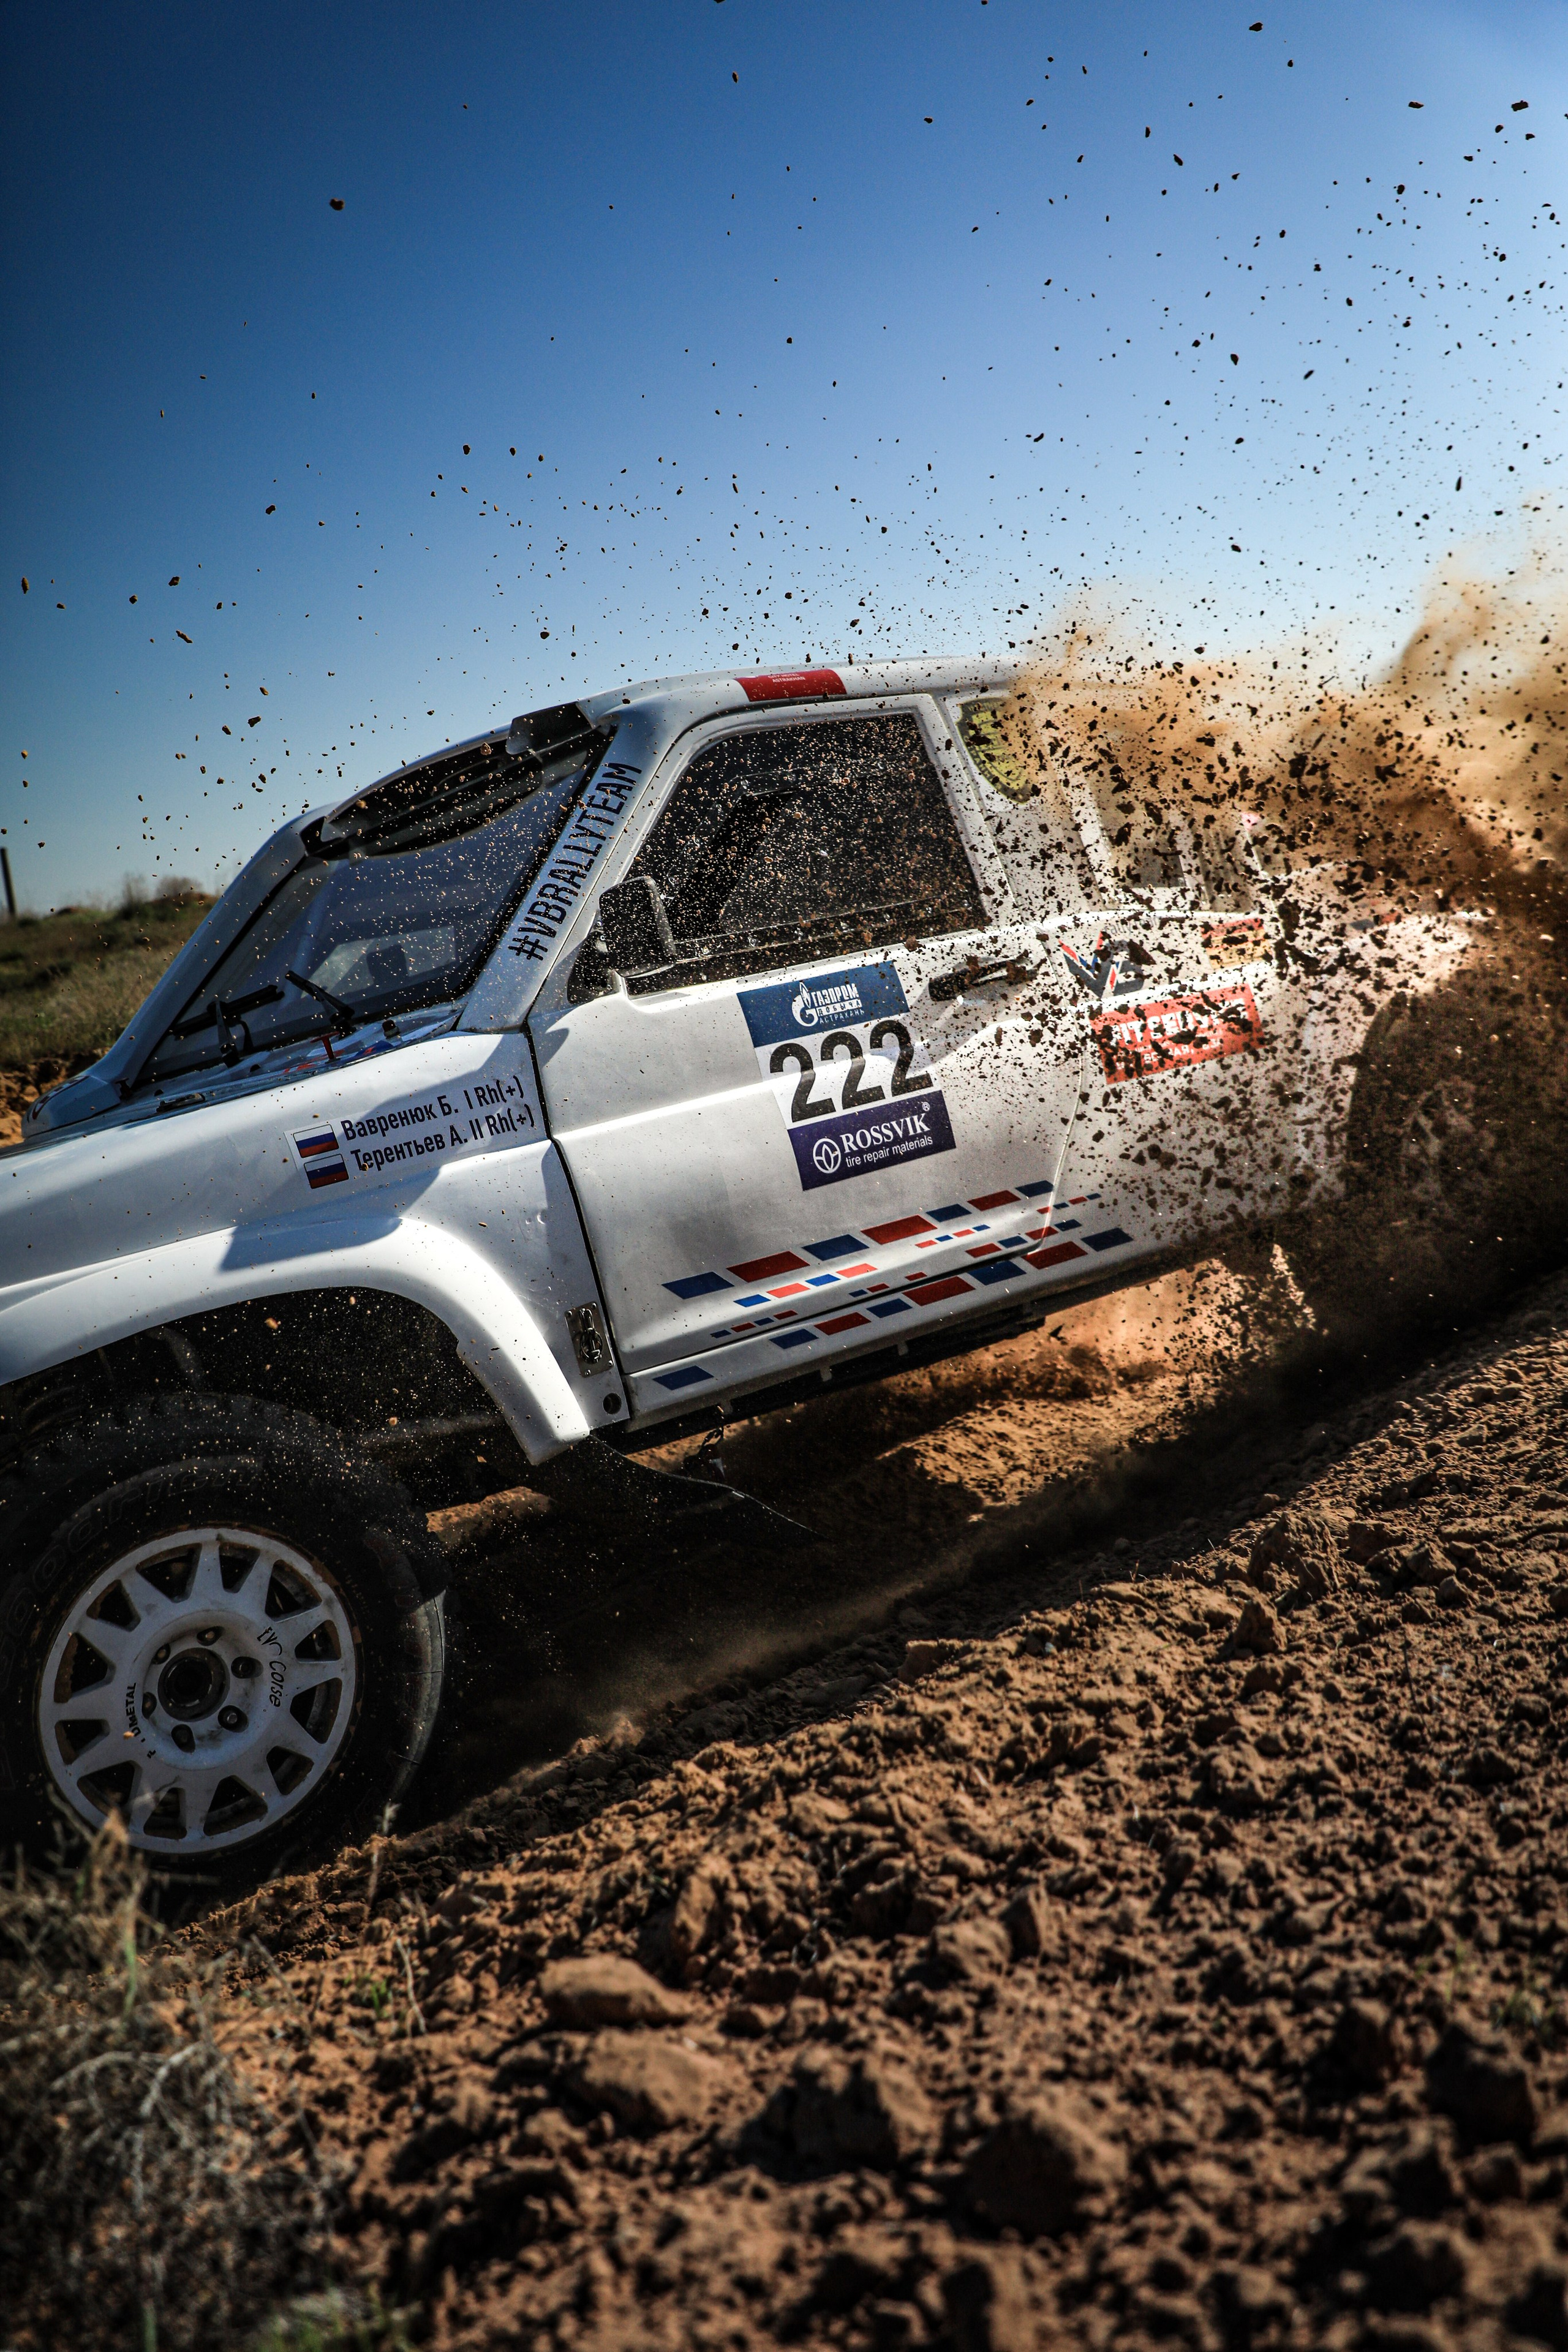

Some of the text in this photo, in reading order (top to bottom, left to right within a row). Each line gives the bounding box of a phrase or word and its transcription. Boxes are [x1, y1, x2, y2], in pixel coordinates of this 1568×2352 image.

[508, 762, 643, 961] #VBRALLYTEAM
[811, 983, 859, 1006] ГАЗПРОМ
[818, 999, 861, 1016] ДОБЫЧА
[820, 1009, 865, 1024] АСТРАХАНЬ
[769, 1019, 934, 1123] 222
[341, 1103, 437, 1140] Вавренюк
[437, 1095, 459, 1117] Б.
[474, 1075, 524, 1107] Rh(+)
[350, 1134, 445, 1171] Терентьев
[450, 1125, 468, 1147] А.
[484, 1104, 535, 1136] Rh(+)
[840, 1113, 930, 1153] ROSSVIK
[845, 1135, 933, 1167] tire repair materials
[269, 1660, 287, 1708] Corse
